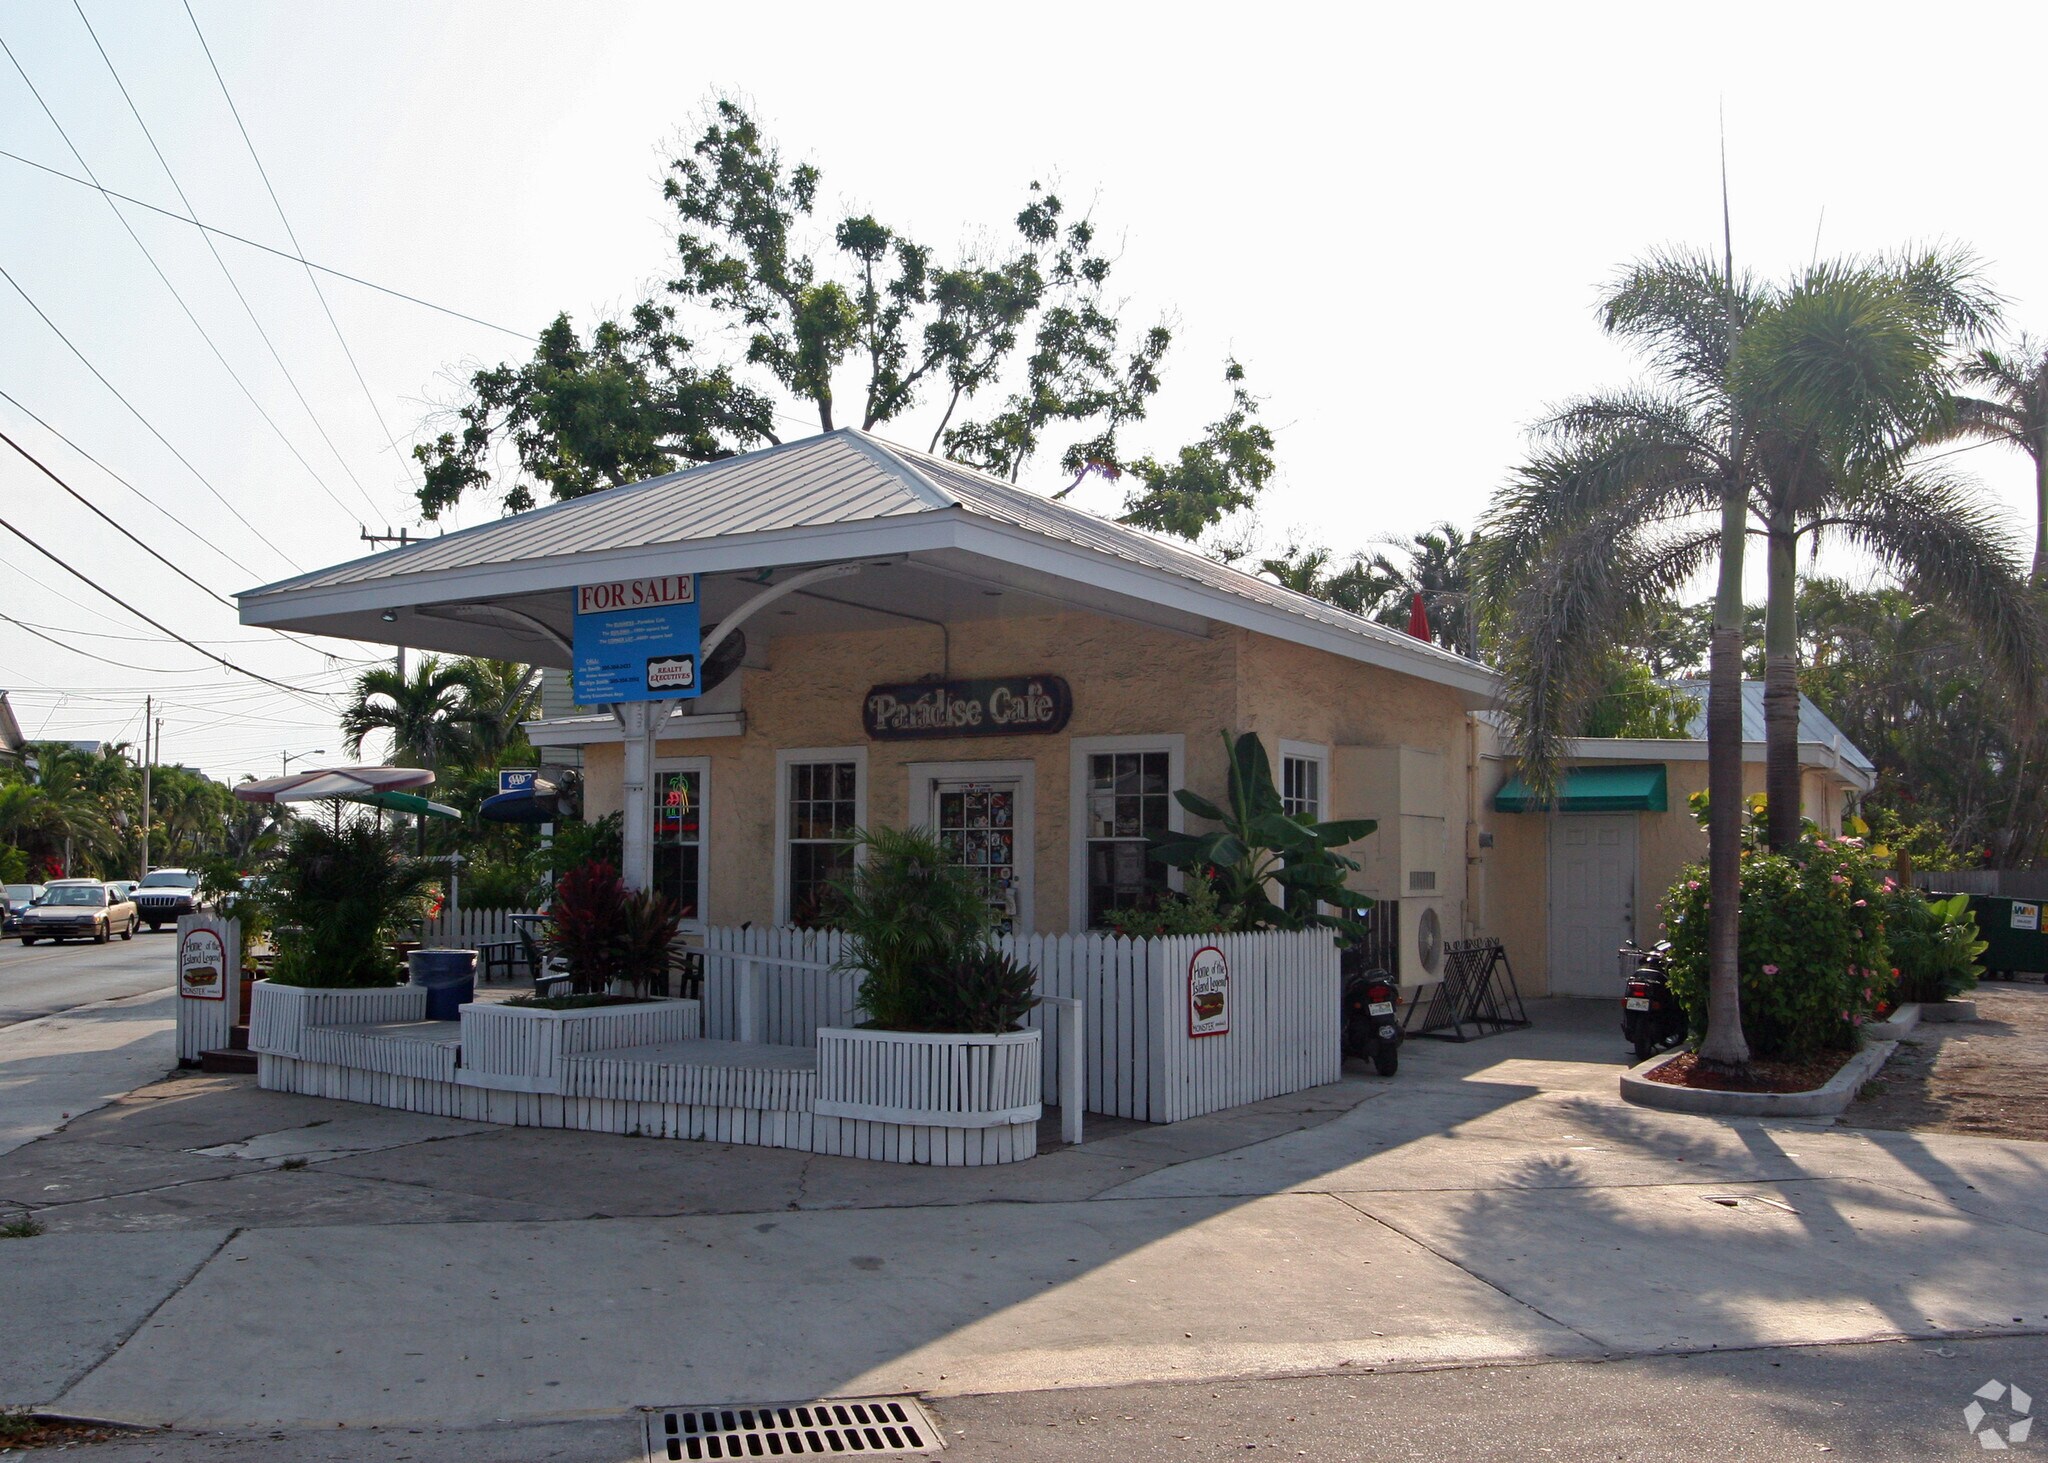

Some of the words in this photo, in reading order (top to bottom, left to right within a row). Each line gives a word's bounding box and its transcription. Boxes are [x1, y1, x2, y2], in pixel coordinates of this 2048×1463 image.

[582, 583, 626, 610] FOR
[632, 575, 691, 605] SALE
[658, 666, 682, 674] REALTY
[650, 673, 691, 683] EXECUTIVES
[869, 689, 982, 730] Paradise
[2014, 906, 2035, 915] WM
[185, 938, 202, 953] Home
[205, 941, 212, 950] of
[212, 940, 220, 950] the
[183, 953, 201, 967] Island
[202, 951, 220, 965] Legend
[1193, 961, 1209, 978] Home
[1211, 960, 1217, 975] of
[1217, 959, 1225, 974] the
[182, 987, 206, 995] MONSTER
[1192, 978, 1209, 996] Island
[1210, 977, 1226, 992] Legend
[1192, 1022, 1215, 1032] MONSTER
